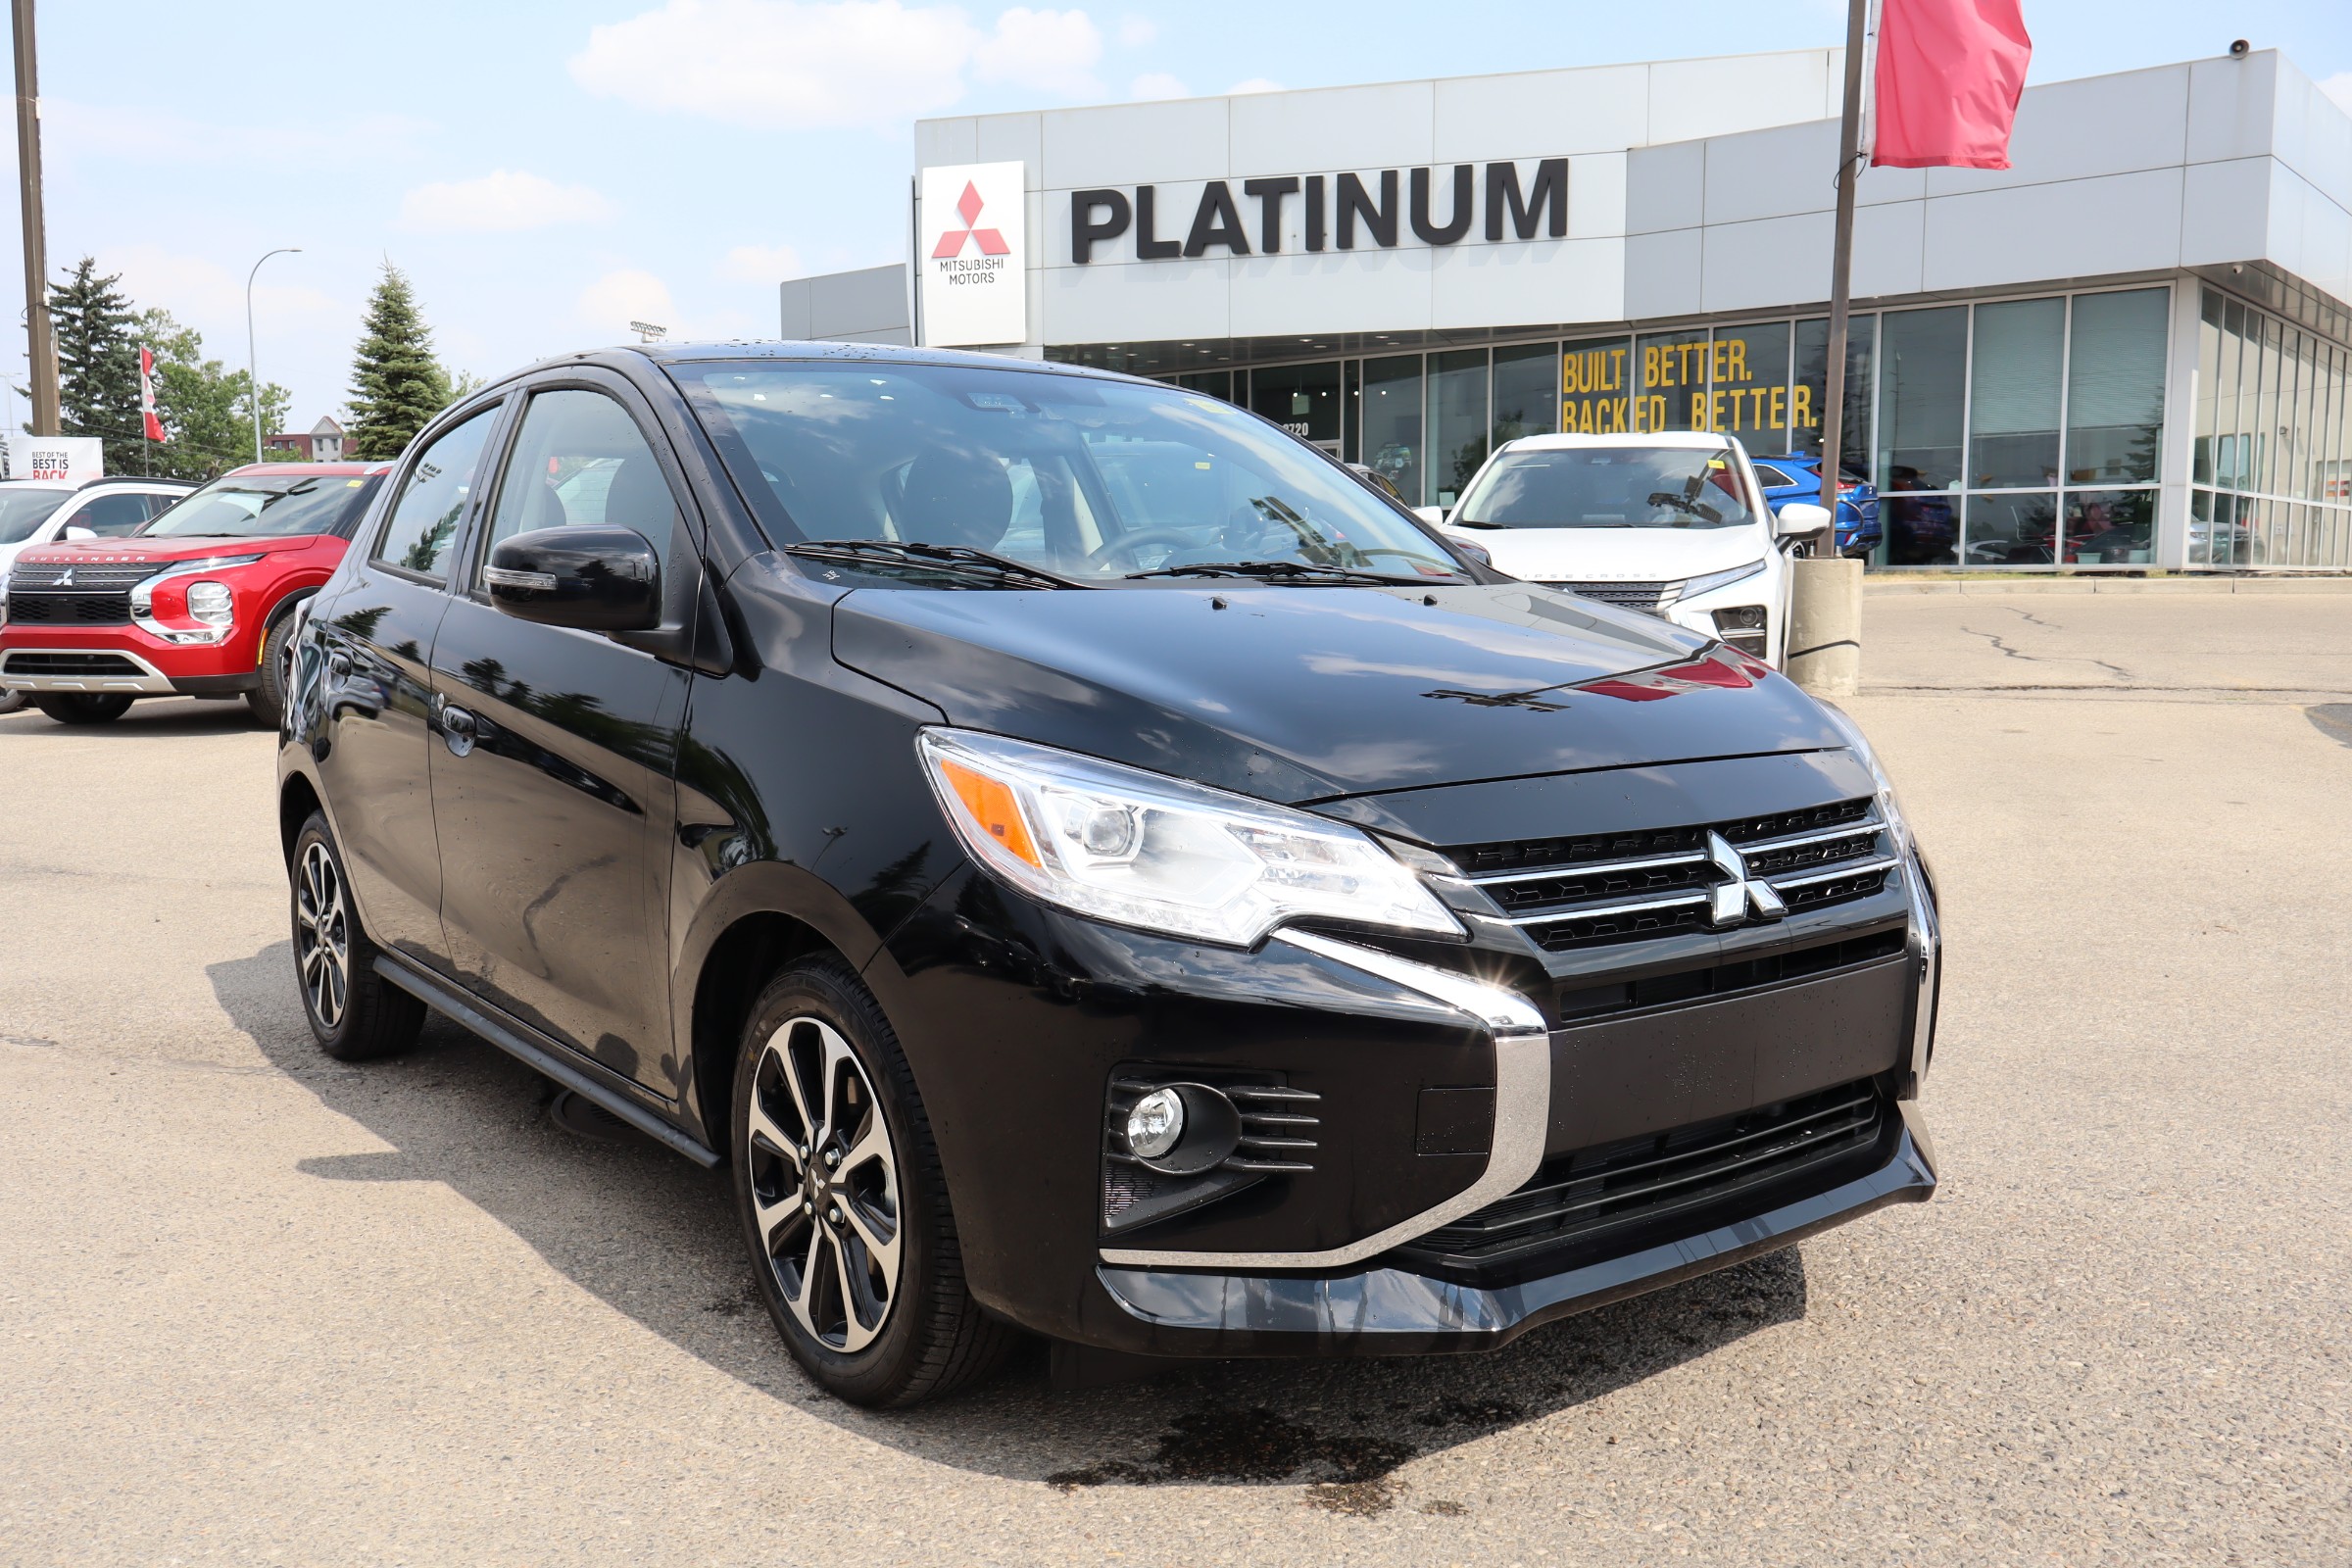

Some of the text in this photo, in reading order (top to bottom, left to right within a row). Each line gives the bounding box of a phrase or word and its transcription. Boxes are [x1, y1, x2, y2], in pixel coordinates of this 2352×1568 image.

[1072, 158, 1569, 265] PLATINUM
[940, 258, 1004, 272] MITSUBISHI
[949, 271, 995, 285] MOTORS
[1563, 339, 1752, 394] BUILT BETTER.
[1562, 385, 1818, 434] BACKED BETTER.
[32, 459, 69, 469] BEST IS
